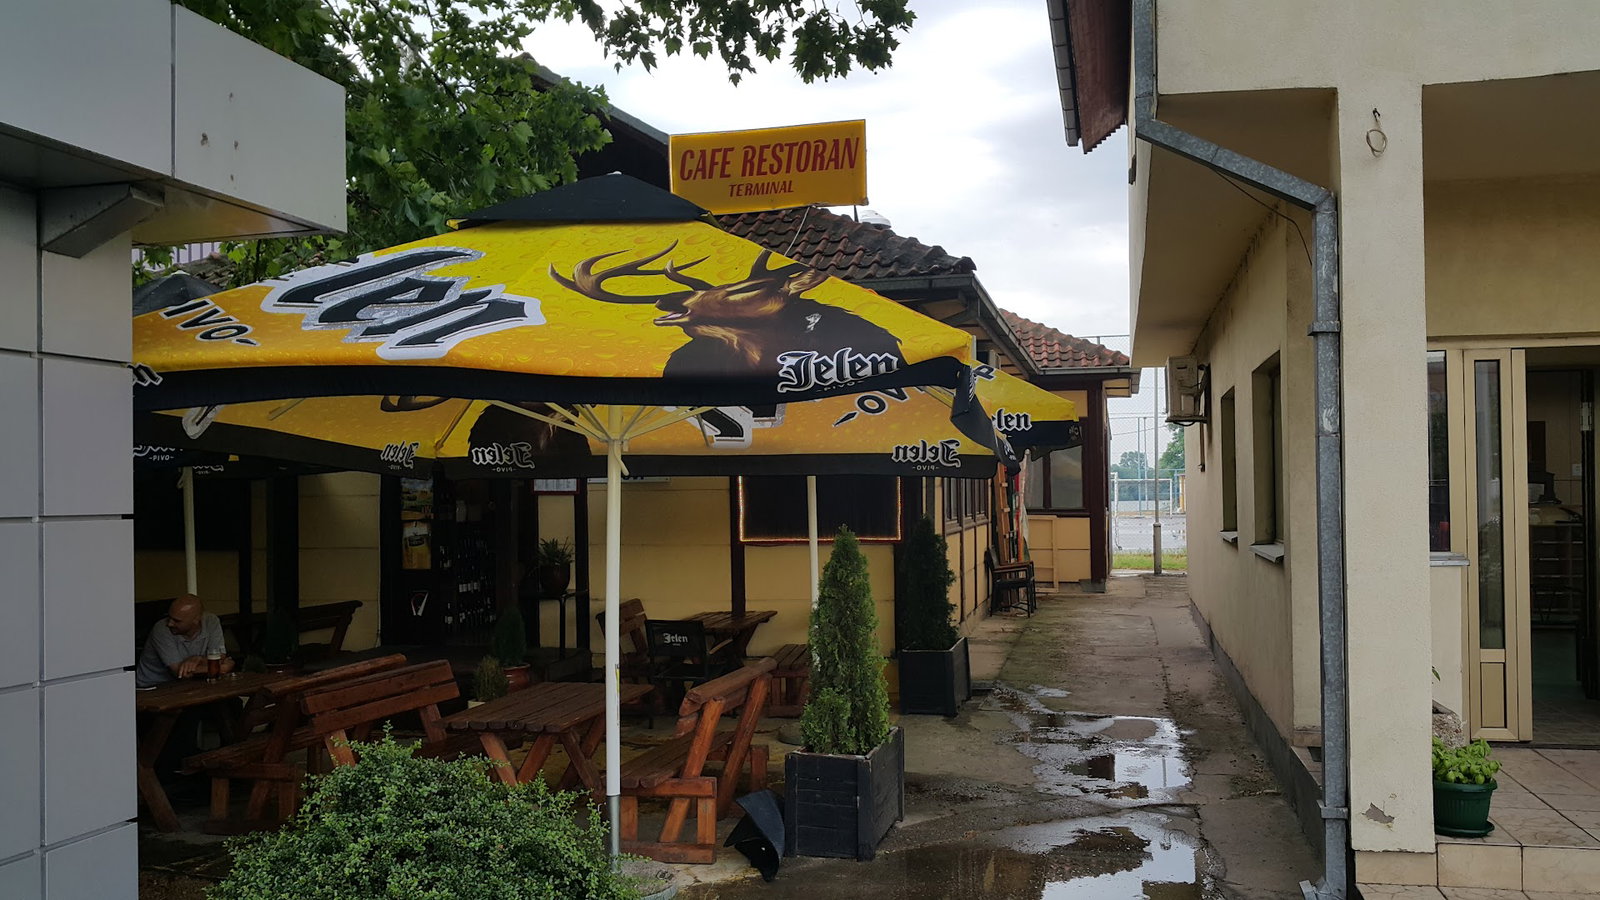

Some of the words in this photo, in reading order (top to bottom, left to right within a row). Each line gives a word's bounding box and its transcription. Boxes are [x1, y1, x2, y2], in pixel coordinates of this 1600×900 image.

[679, 147, 735, 181] CAFE
[741, 137, 860, 178] RESTORAN
[728, 180, 794, 198] TERMINAL
[776, 347, 900, 394] Jelen
[992, 408, 1033, 432] len
